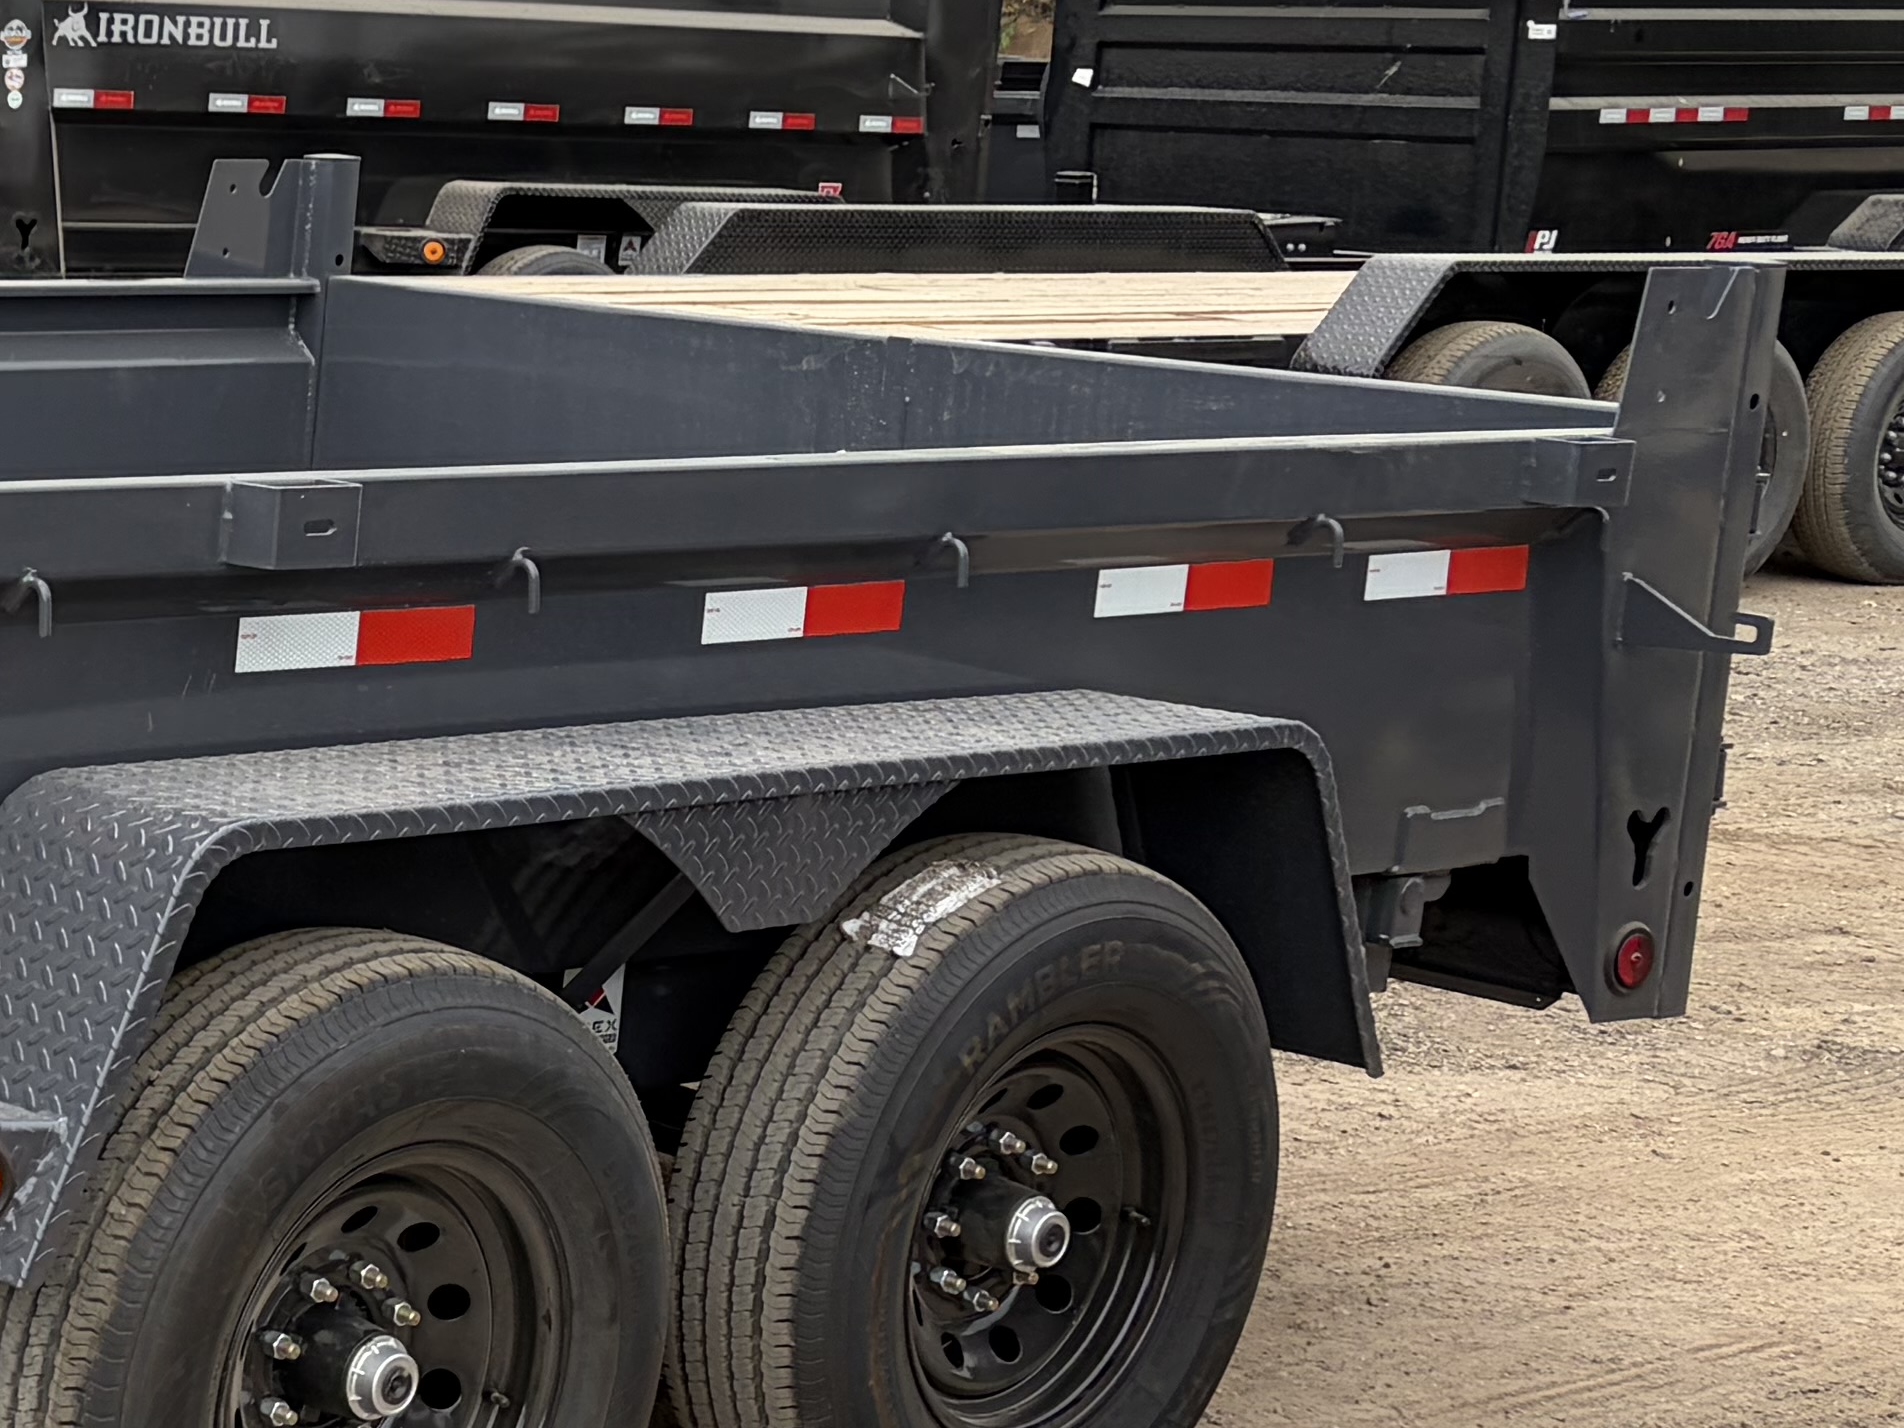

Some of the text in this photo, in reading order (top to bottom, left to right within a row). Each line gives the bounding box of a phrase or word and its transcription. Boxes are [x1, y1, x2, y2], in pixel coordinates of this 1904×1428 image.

[96, 12, 278, 49] IRONBULL
[1533, 229, 1558, 250] PJ
[958, 939, 1125, 1071] RAMBLER
